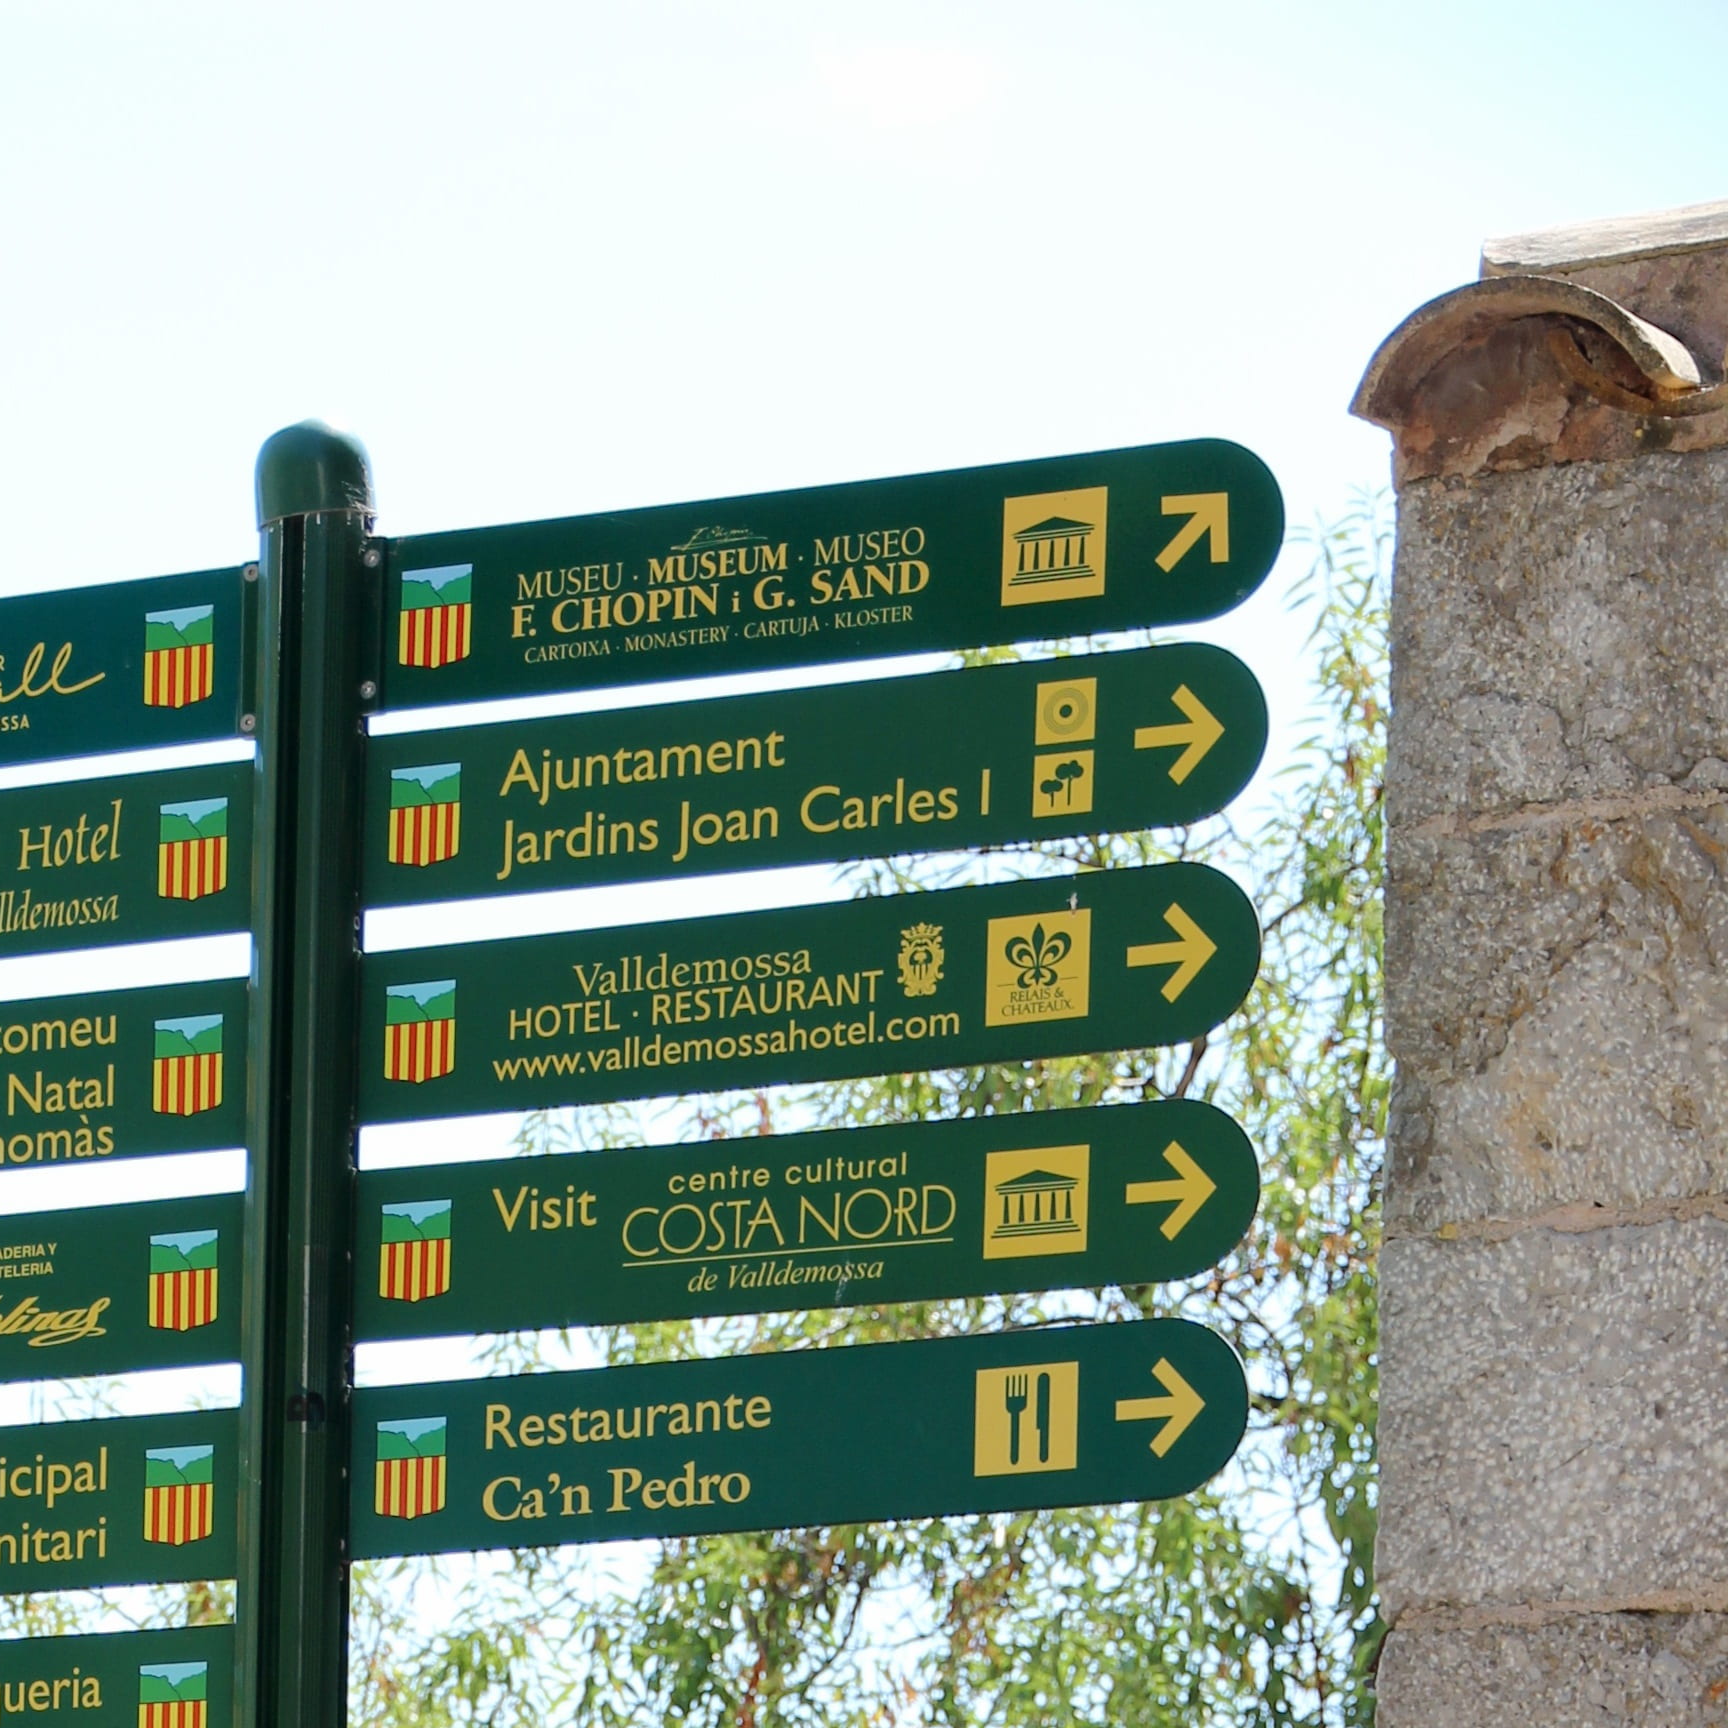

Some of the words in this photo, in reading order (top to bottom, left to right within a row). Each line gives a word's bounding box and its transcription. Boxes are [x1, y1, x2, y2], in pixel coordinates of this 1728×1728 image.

[518, 562, 625, 602] MUSEU
[648, 541, 788, 586] MUSEUM
[815, 526, 925, 567] MUSEO
[511, 603, 537, 639] F.
[550, 583, 718, 636] CHOPIN
[731, 590, 740, 614] i
[753, 574, 796, 611] G.
[810, 556, 930, 606] SAND
[524, 641, 609, 666] CARTOIXA
[626, 626, 727, 655] MONASTERY
[743, 617, 819, 640] CARTUJA
[835, 604, 912, 629] KLOSTER
[500, 732, 784, 805] Ajuntament
[19, 800, 122, 870] Hotel
[497, 812, 658, 880] Jardins
[673, 801, 778, 861] Joan
[801, 778, 958, 832] Carles
[572, 949, 811, 995] Valldemossa
[1010, 988, 1051, 1002] RELAIS
[1054, 987, 1064, 998] &
[509, 998, 621, 1042] HOTEL
[650, 971, 882, 1024] RESTAURANT
[493, 1010, 960, 1083] www.valldemossahotel.com
[8, 1064, 114, 1115] Natal
[669, 1166, 770, 1193] centre
[786, 1152, 906, 1184] cultural
[493, 1185, 596, 1232] Visit
[623, 1198, 784, 1256] COSTA
[799, 1185, 956, 1243] NORD
[47, 1242, 57, 1256] Y
[688, 1268, 717, 1292] de
[730, 1260, 883, 1288] Valldemossa
[486, 1396, 771, 1449] Restaurante
[609, 1461, 750, 1511] Pedro
